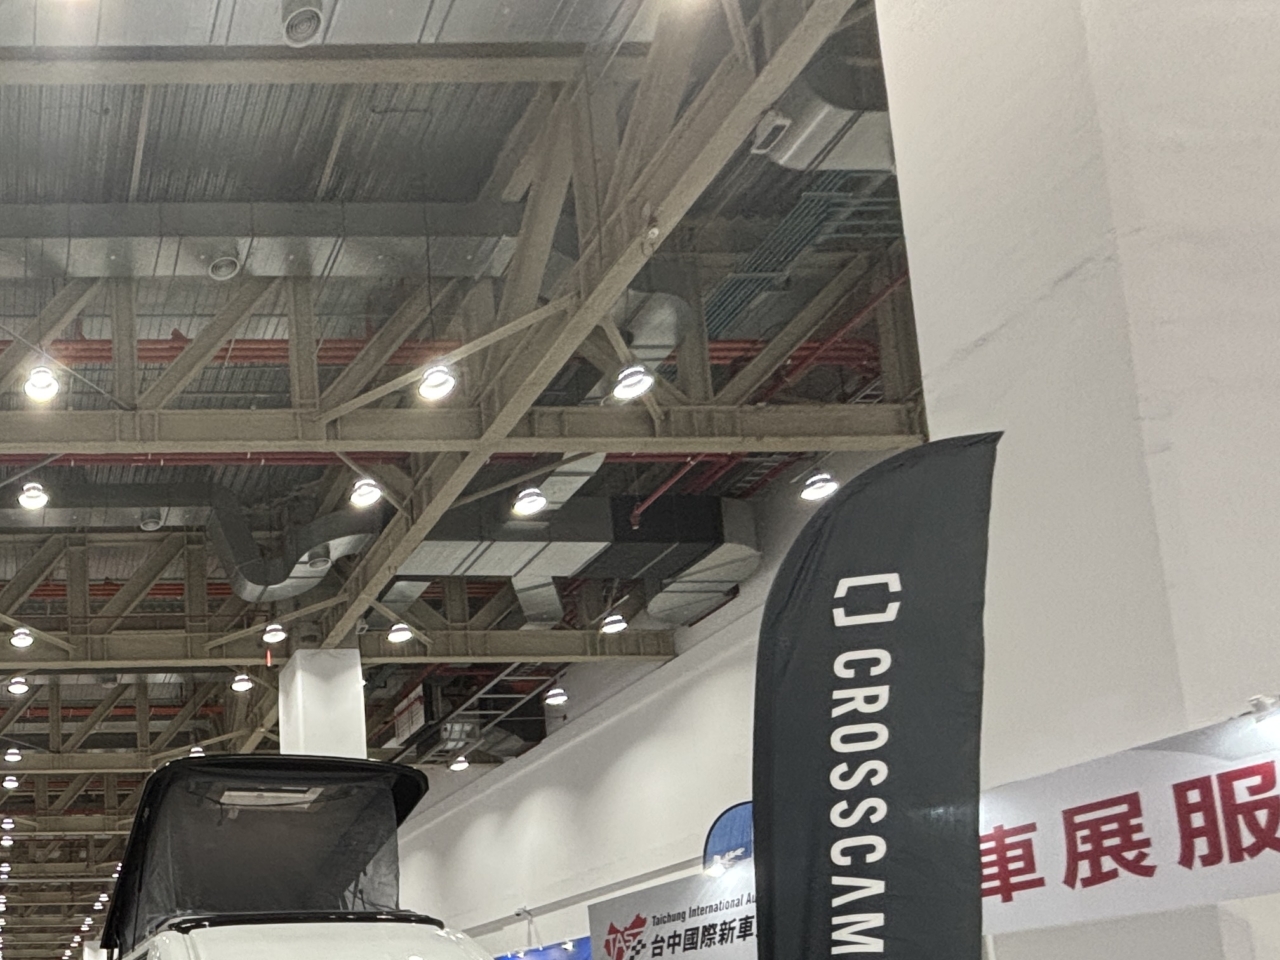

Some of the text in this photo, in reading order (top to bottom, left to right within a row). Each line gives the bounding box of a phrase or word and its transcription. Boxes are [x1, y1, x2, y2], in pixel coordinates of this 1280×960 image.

[980, 760, 1280, 903] 車展服
[651, 910, 687, 927] Taichung
[688, 894, 744, 919] International
[651, 915, 758, 958] 台中國際新車
